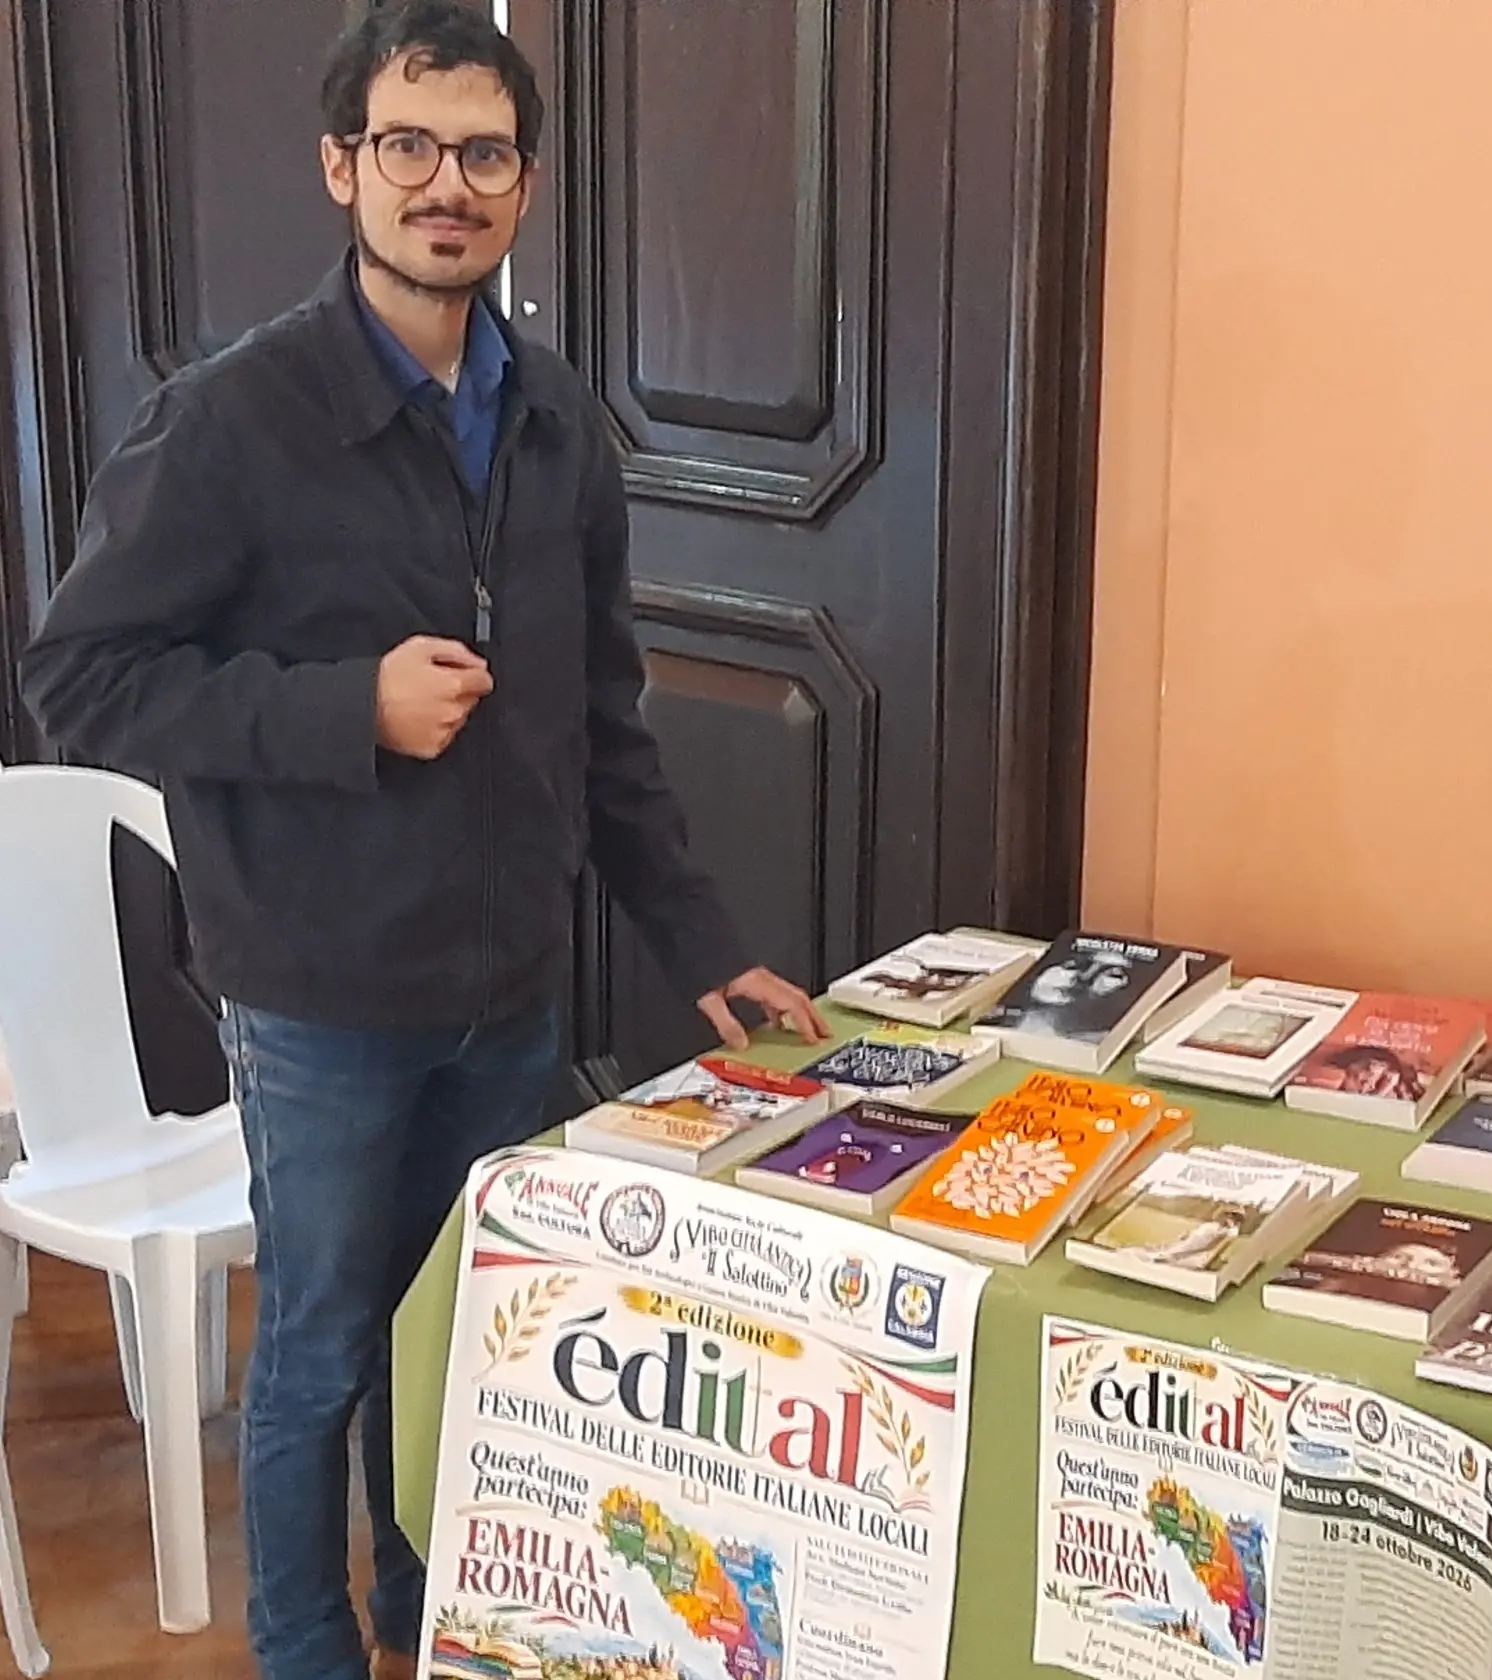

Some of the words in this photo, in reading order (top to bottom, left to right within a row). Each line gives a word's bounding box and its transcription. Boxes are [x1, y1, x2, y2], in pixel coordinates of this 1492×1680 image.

[677, 1302, 775, 1349] edizione
[1054, 1415, 1103, 1444] FESTIVAL
[469, 1440, 589, 1496] Quest'anno
[478, 1386, 576, 1440] FESTIVAL
[580, 1417, 646, 1463] DELLE
[651, 1439, 747, 1497] EDITORIE
[753, 1468, 851, 1532] ITALIANE
[857, 1510, 930, 1557] LOCALI
[1056, 1449, 1139, 1489] Quest'anno
[473, 1472, 588, 1520] partecipa:
[466, 1517, 611, 1584] EMILIA-
[1057, 1512, 1156, 1564] EMILIA-
[1376, 1532, 1434, 1573] ottobre
[456, 1555, 637, 1638] ROMAGNA
[1055, 1543, 1172, 1605] ROMAGNA
